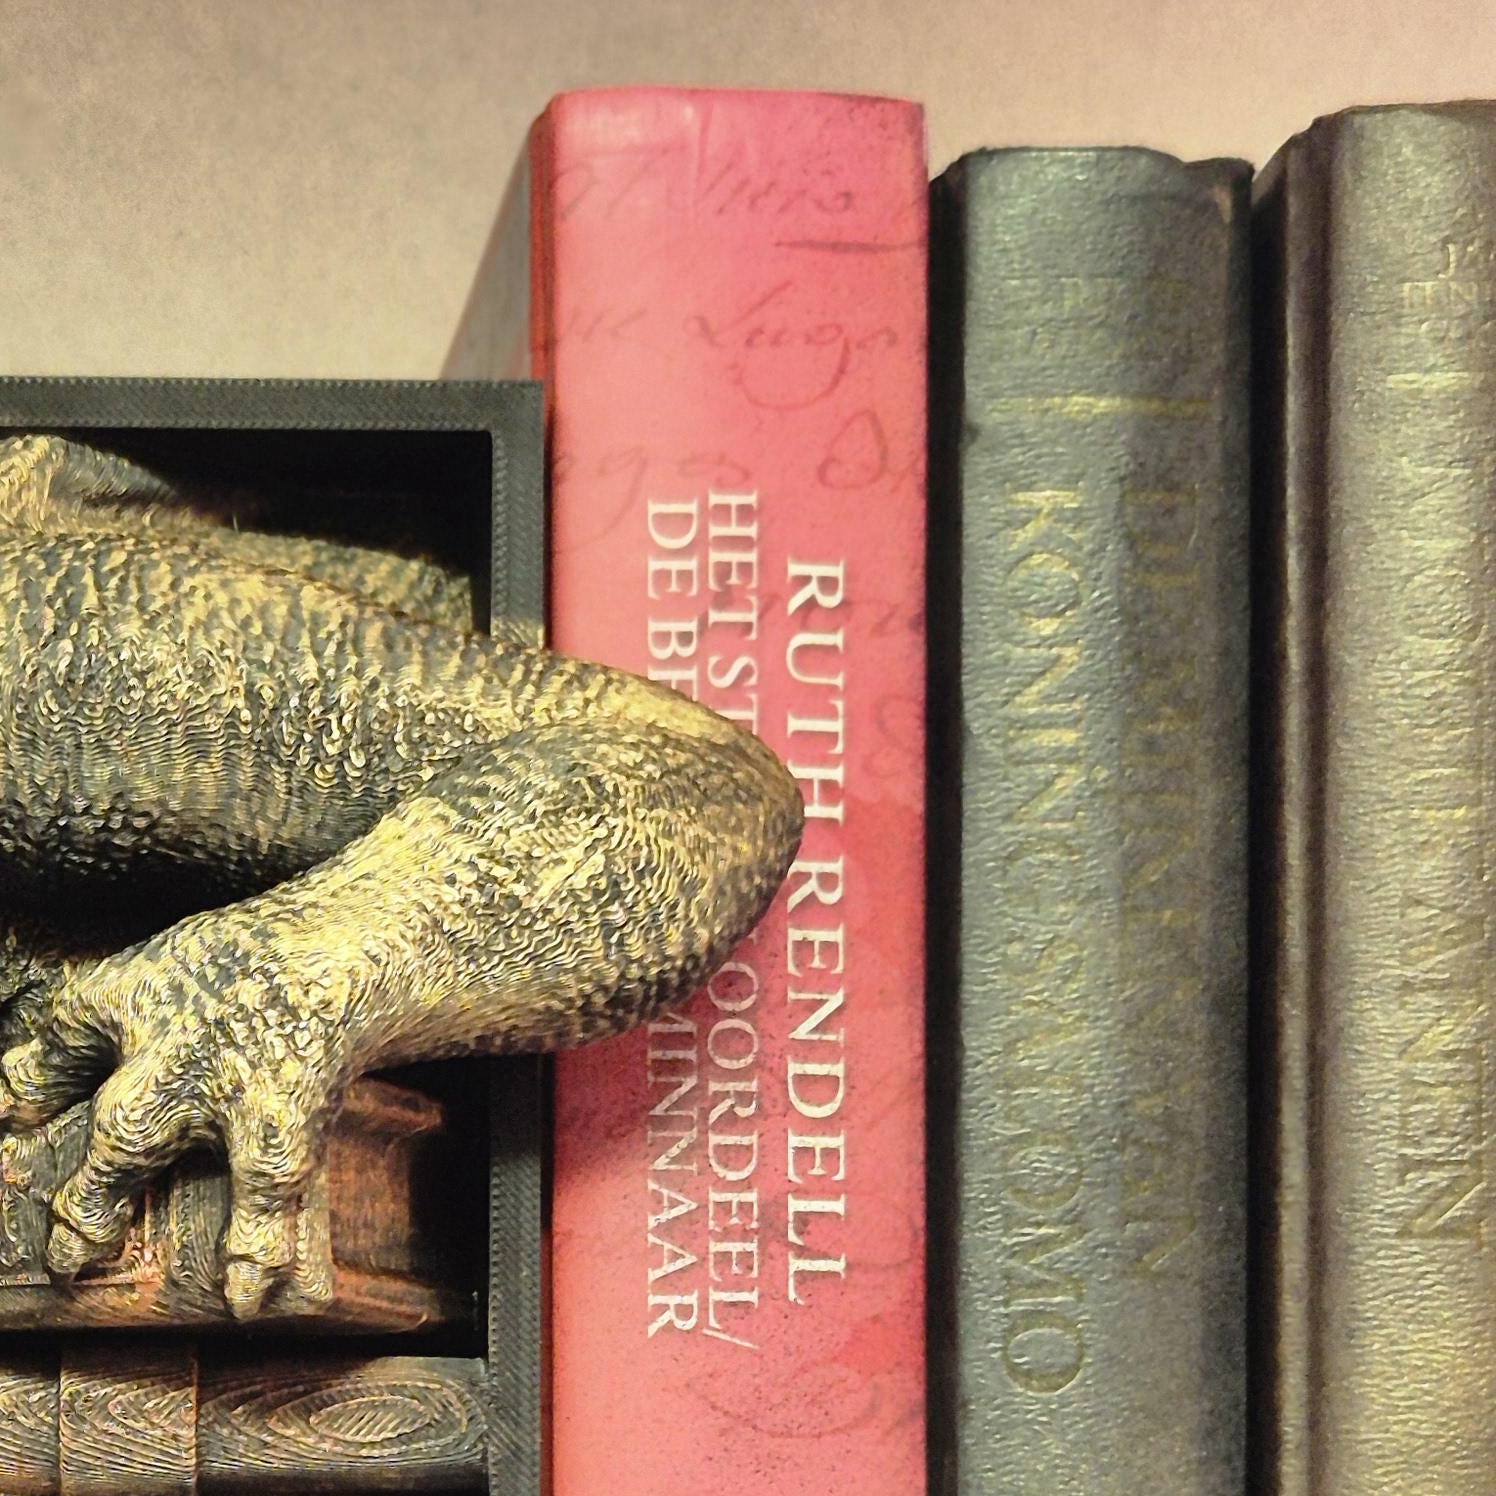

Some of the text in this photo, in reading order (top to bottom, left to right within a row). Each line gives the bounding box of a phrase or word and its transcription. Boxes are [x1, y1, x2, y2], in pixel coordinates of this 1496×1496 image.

[647, 498, 699, 600] DE
[707, 489, 759, 641] HET
[786, 556, 847, 1306] RUTH RENDELL
